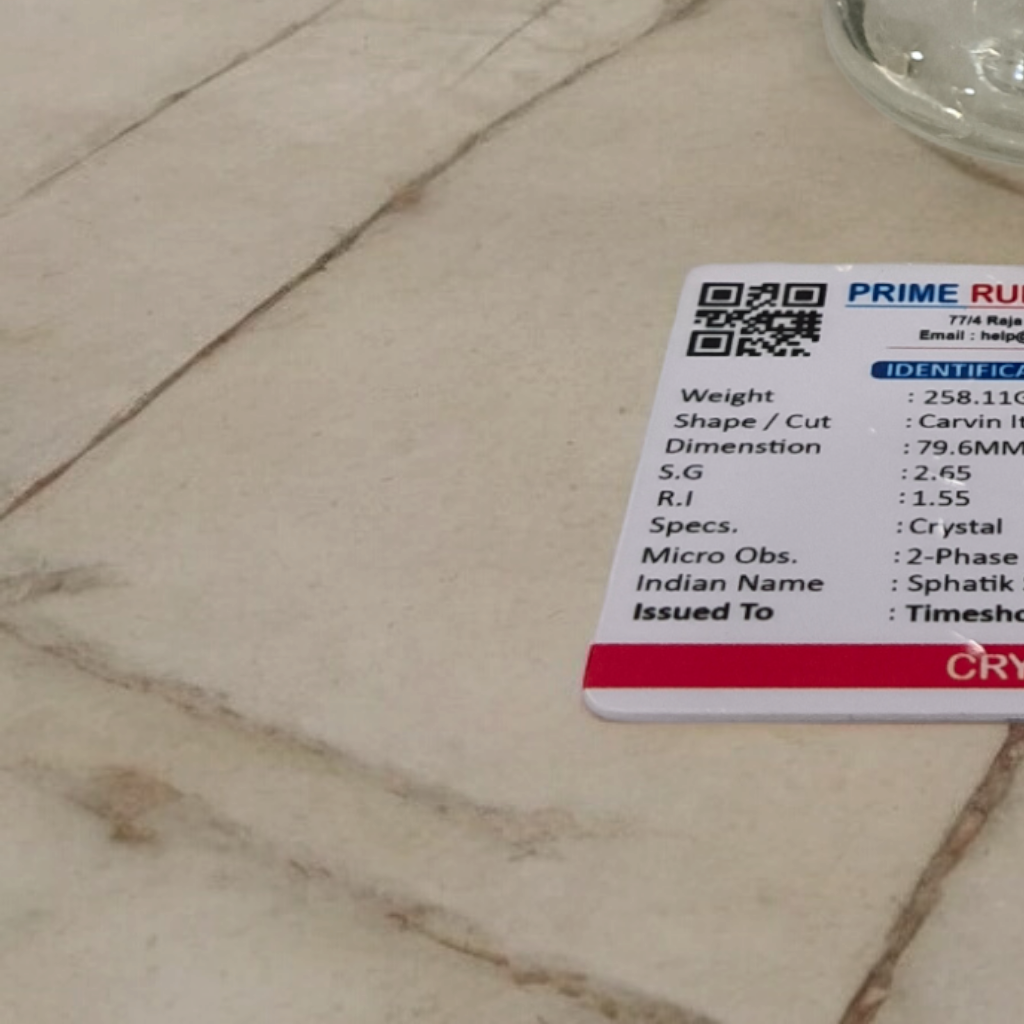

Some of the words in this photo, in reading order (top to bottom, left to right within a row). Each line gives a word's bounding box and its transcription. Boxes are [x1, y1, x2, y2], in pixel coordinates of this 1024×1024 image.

[848, 283, 958, 304] PRIME
[949, 315, 981, 326] 77/4
[987, 315, 1022, 328] Raja
[919, 330, 965, 340] Email
[682, 388, 774, 406] Weight
[674, 413, 761, 433] Shape
[785, 413, 831, 430] Cut
[919, 413, 1002, 430] Carvin
[666, 438, 821, 455] Dimenstion
[659, 465, 703, 480] S.G
[914, 465, 972, 481] 2.65
[658, 490, 694, 507] R.I
[913, 490, 970, 506] 1.55
[649, 517, 738, 537] Specs.
[910, 518, 1002, 539] Crystal
[642, 547, 725, 564] Micro
[734, 547, 797, 564] Obs.
[907, 548, 1018, 565] 2-Phase
[637, 575, 726, 592] Indian
[738, 576, 825, 592] Name
[907, 575, 1014, 595] Sphatik
[633, 602, 730, 621] Issued
[738, 603, 774, 621] To
